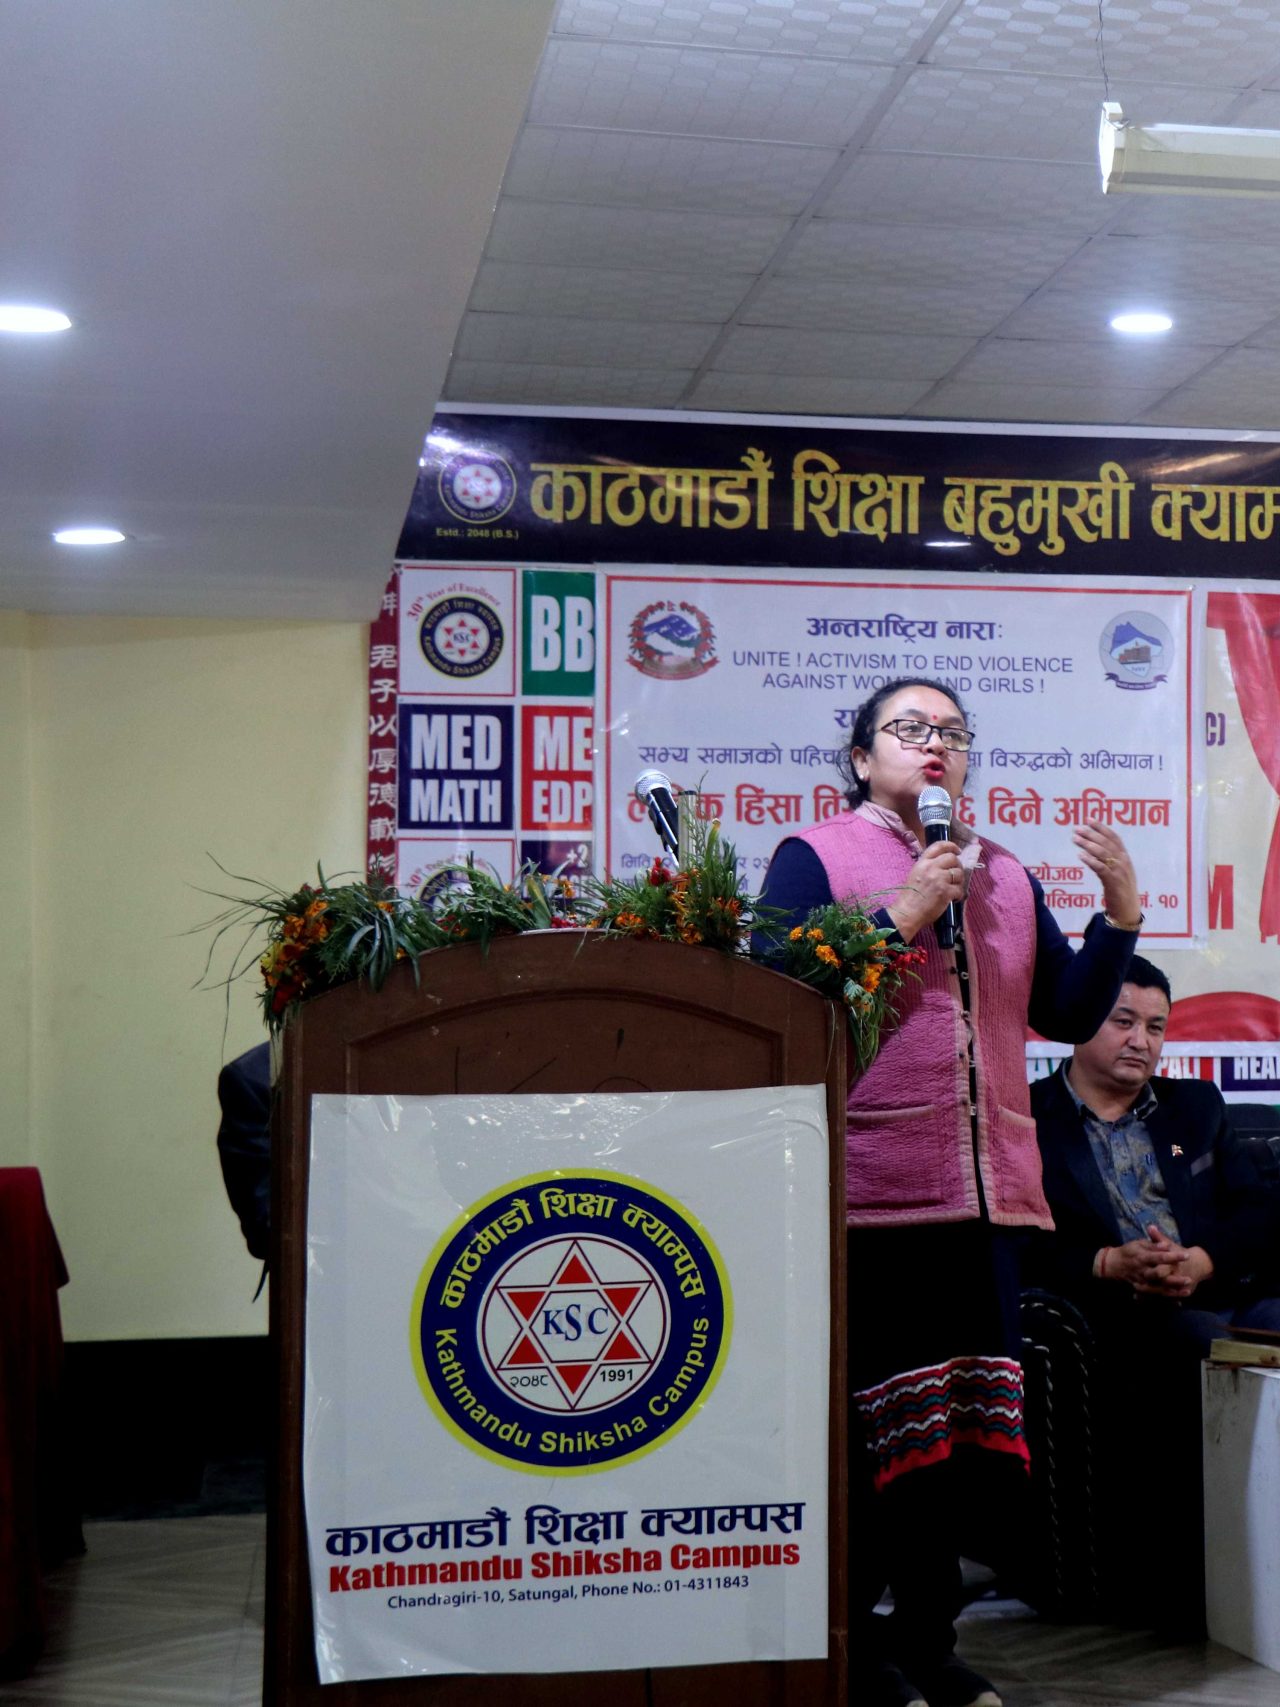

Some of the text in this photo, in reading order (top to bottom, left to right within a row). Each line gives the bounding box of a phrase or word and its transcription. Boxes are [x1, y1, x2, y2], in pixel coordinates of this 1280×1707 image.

[792, 449, 925, 543] शिक्षा
[943, 461, 1135, 557] बहुमुखी
[467, 528, 490, 538] 2048
[733, 651, 790, 667] UNITE
[806, 652, 896, 669] ACTIVISM
[902, 654, 930, 670] TO
[934, 655, 973, 671] END
[977, 656, 1073, 673] VIOLENCE
[763, 673, 847, 690] AGAINST
[977, 676, 1035, 693] GIRLS
[411, 713, 501, 771] MED
[638, 746, 688, 764] सभ्य
[697, 742, 783, 765] समाजको
[991, 747, 1072, 771] विरुद्धको
[1080, 750, 1154, 770] अभियान
[411, 779, 501, 823] MATH
[736, 783, 803, 825] हिंसा
[988, 786, 1043, 827] दिने
[1054, 788, 1172, 827] अभियान
[1158, 894, 1178, 909] १०
[539, 1187, 618, 1220] शिक्षा
[622, 1202, 707, 1299] क्याम्पस
[543, 1304, 609, 1342] KSC
[435, 1316, 710, 1454] Kathmandu Shiksha Campus
[510, 1374, 550, 1388] २०४८
[600, 1368, 633, 1383] 1991
[525, 1504, 627, 1546] शिक्षा
[641, 1502, 806, 1538] क्याम्पस
[329, 1543, 801, 1593] Kathmandu Shiksha Campus
[387, 1574, 750, 1610] Chandragiri-10, Satungal, Phone No.: 01-4311843
